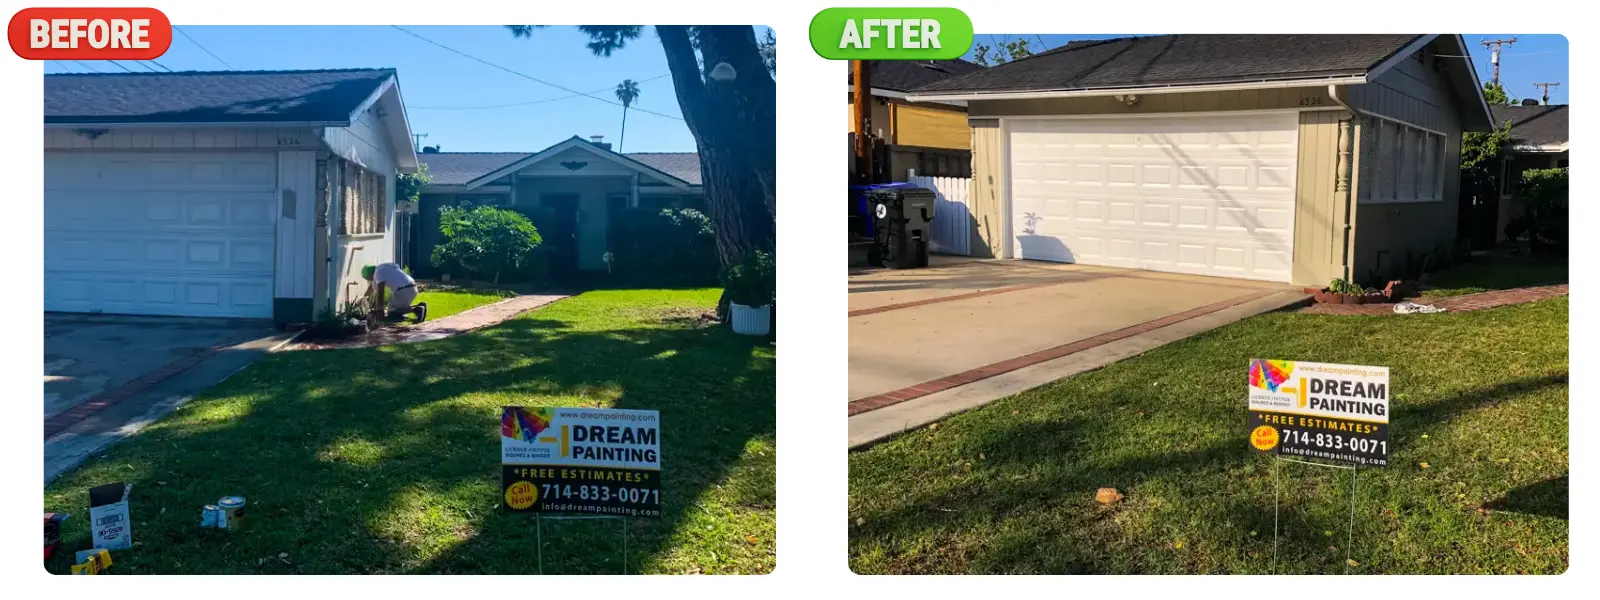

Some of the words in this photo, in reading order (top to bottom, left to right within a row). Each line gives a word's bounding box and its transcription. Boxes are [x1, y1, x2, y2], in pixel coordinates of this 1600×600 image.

[1299, 366, 1386, 378] www.dreampainting.com
[1310, 378, 1386, 400] DREAM
[1310, 397, 1386, 417] PAINTING
[560, 411, 656, 422] www.dreampainting.com
[573, 425, 657, 446] DREAM
[1256, 429, 1272, 437] Call
[1256, 437, 1274, 446] Now
[1282, 429, 1387, 455] 714-833-0071
[573, 446, 657, 463] PAINTING
[1282, 446, 1387, 466] info@dreampainting.com
[511, 485, 531, 495] Call
[541, 484, 660, 505] 714-833-0071
[511, 495, 533, 505] Now
[541, 502, 660, 517] info@dreampainting.com
